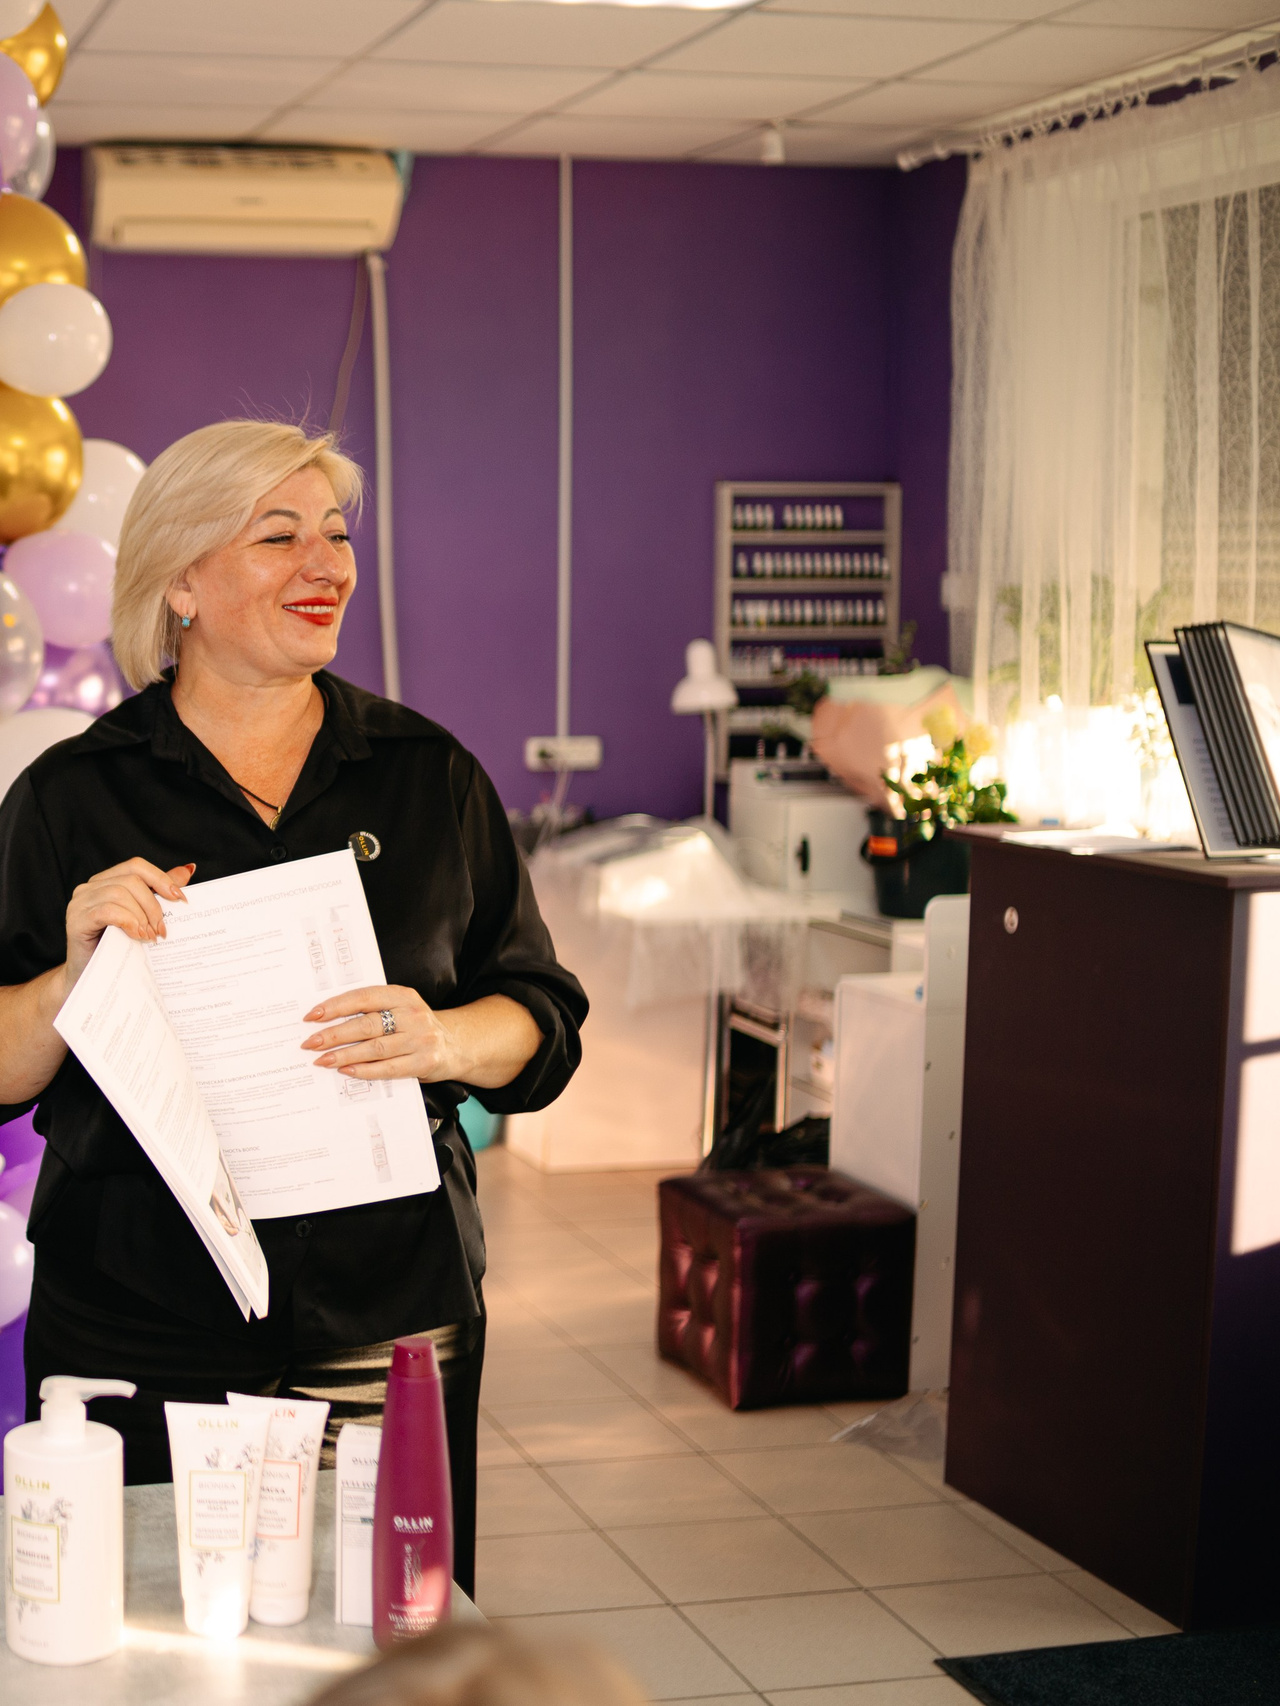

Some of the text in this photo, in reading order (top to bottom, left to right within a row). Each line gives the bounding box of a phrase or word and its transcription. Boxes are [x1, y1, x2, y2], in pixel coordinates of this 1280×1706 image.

[169, 879, 342, 924] СРЕДСТВ ДЛЯ ПРИДАНИЯ ПЛОТНОСТИ ВОЛОСАМ
[275, 1409, 296, 1418] LIN
[197, 1418, 239, 1428] OLLIN
[14, 1474, 51, 1490] OLLIN
[393, 1515, 434, 1530] OLLIN
